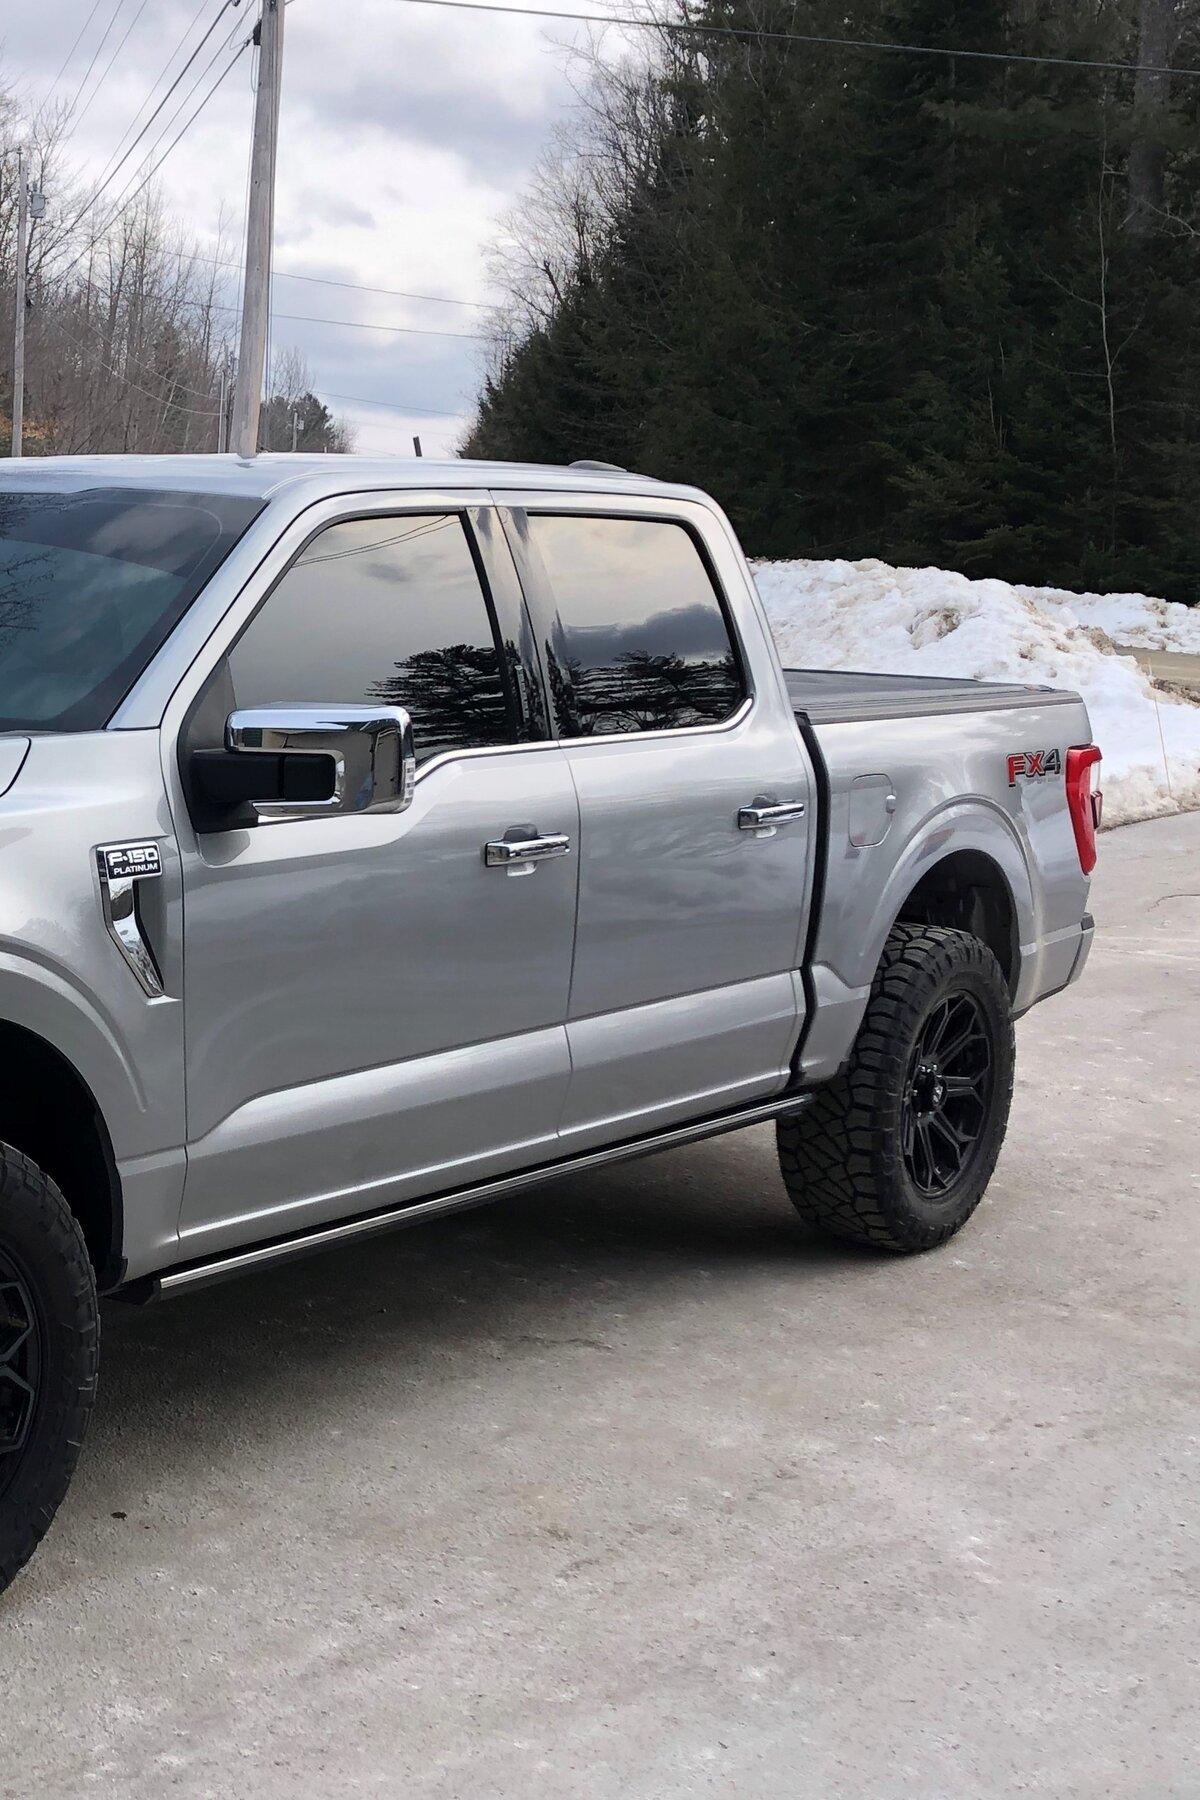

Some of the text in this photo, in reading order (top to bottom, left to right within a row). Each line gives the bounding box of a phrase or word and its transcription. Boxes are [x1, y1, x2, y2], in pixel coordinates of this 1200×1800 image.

[1006, 748, 1061, 787] FX4
[107, 847, 159, 866] F-150
[113, 862, 159, 876] PLATINUM
